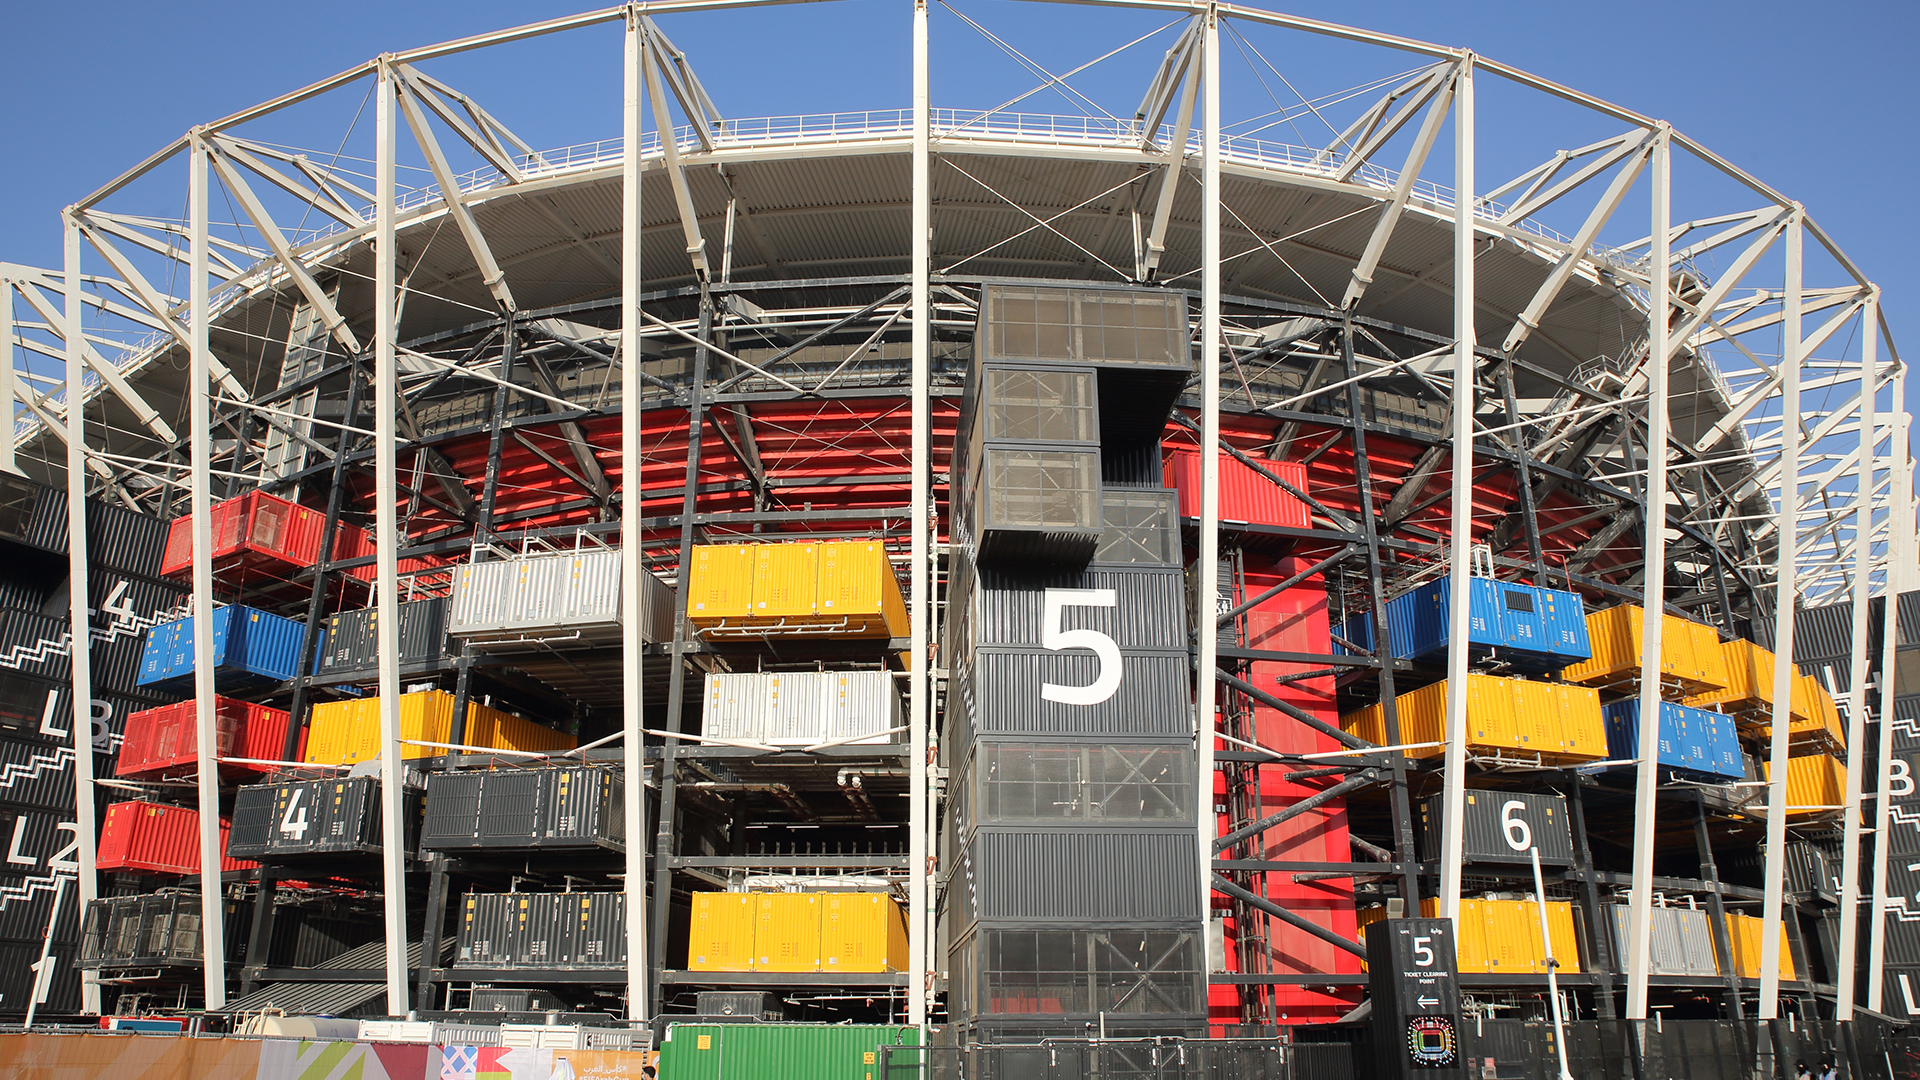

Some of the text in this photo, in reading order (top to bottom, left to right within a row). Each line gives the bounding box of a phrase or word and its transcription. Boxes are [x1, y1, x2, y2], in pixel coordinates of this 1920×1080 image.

[88, 580, 135, 624] 4
[1041, 588, 1122, 705] 5
[280, 788, 308, 840] 4
[1501, 800, 1532, 852] 6
[1413, 936, 1434, 967] 5
